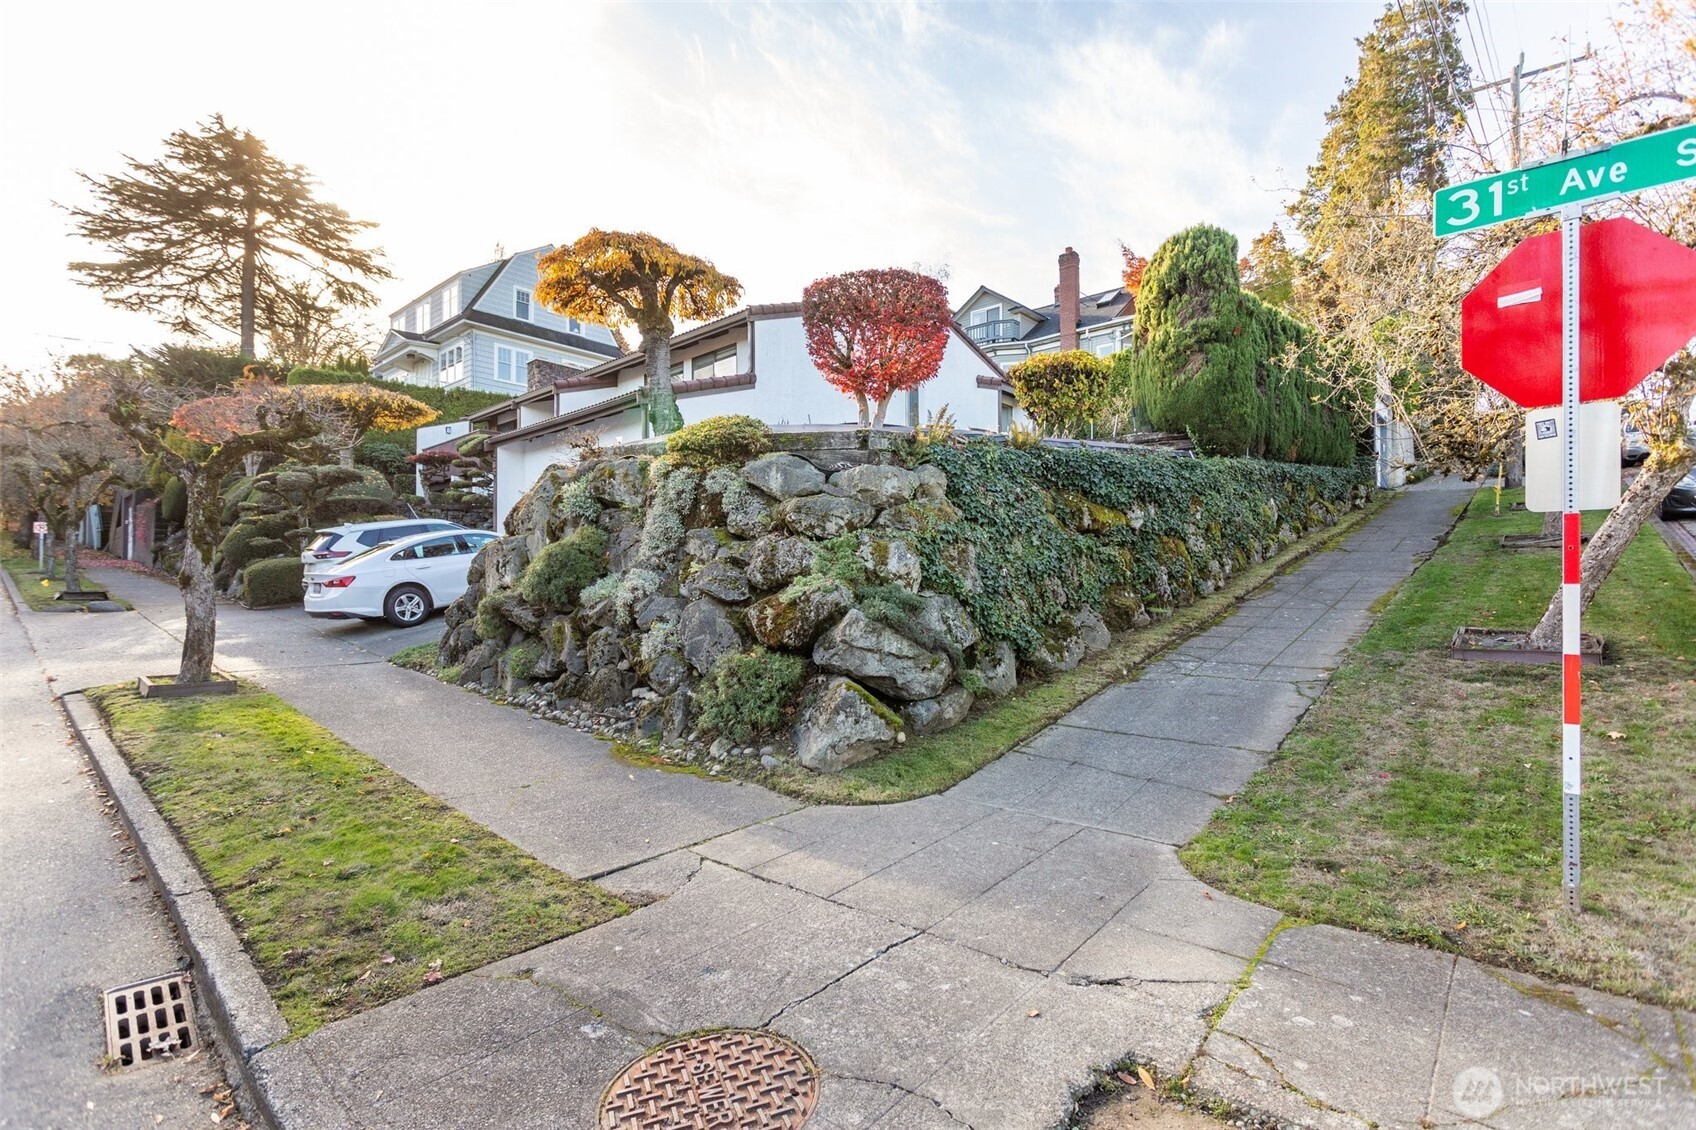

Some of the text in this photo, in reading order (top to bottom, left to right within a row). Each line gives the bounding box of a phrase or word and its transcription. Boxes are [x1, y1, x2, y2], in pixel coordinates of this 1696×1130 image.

[1446, 173, 1529, 227] 31st
[1559, 161, 1628, 196] Ave
[691, 1062, 734, 1129] SEWER
